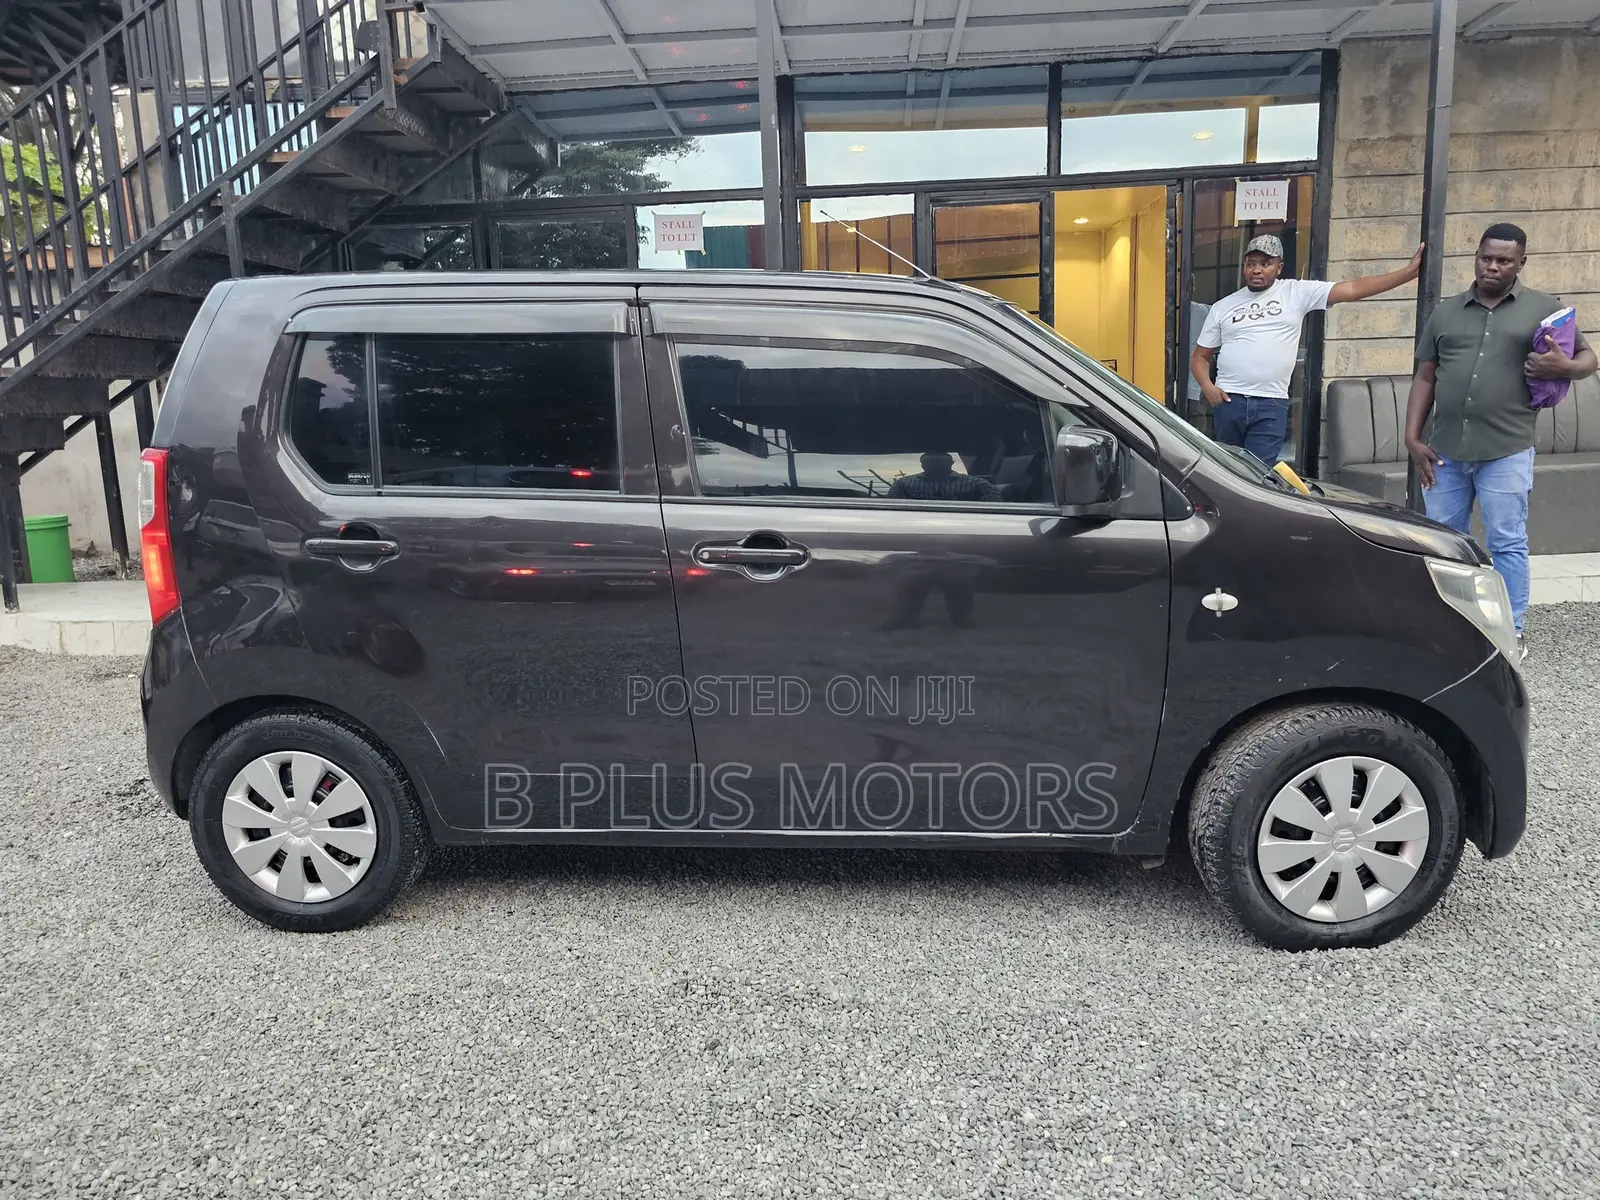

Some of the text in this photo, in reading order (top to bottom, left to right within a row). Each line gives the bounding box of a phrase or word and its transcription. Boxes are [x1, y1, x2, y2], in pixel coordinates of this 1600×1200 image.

[1244, 188, 1280, 197] STALL
[1243, 201, 1280, 210] TO LET
[661, 220, 695, 229] STALL
[660, 233, 697, 242] TO LET
